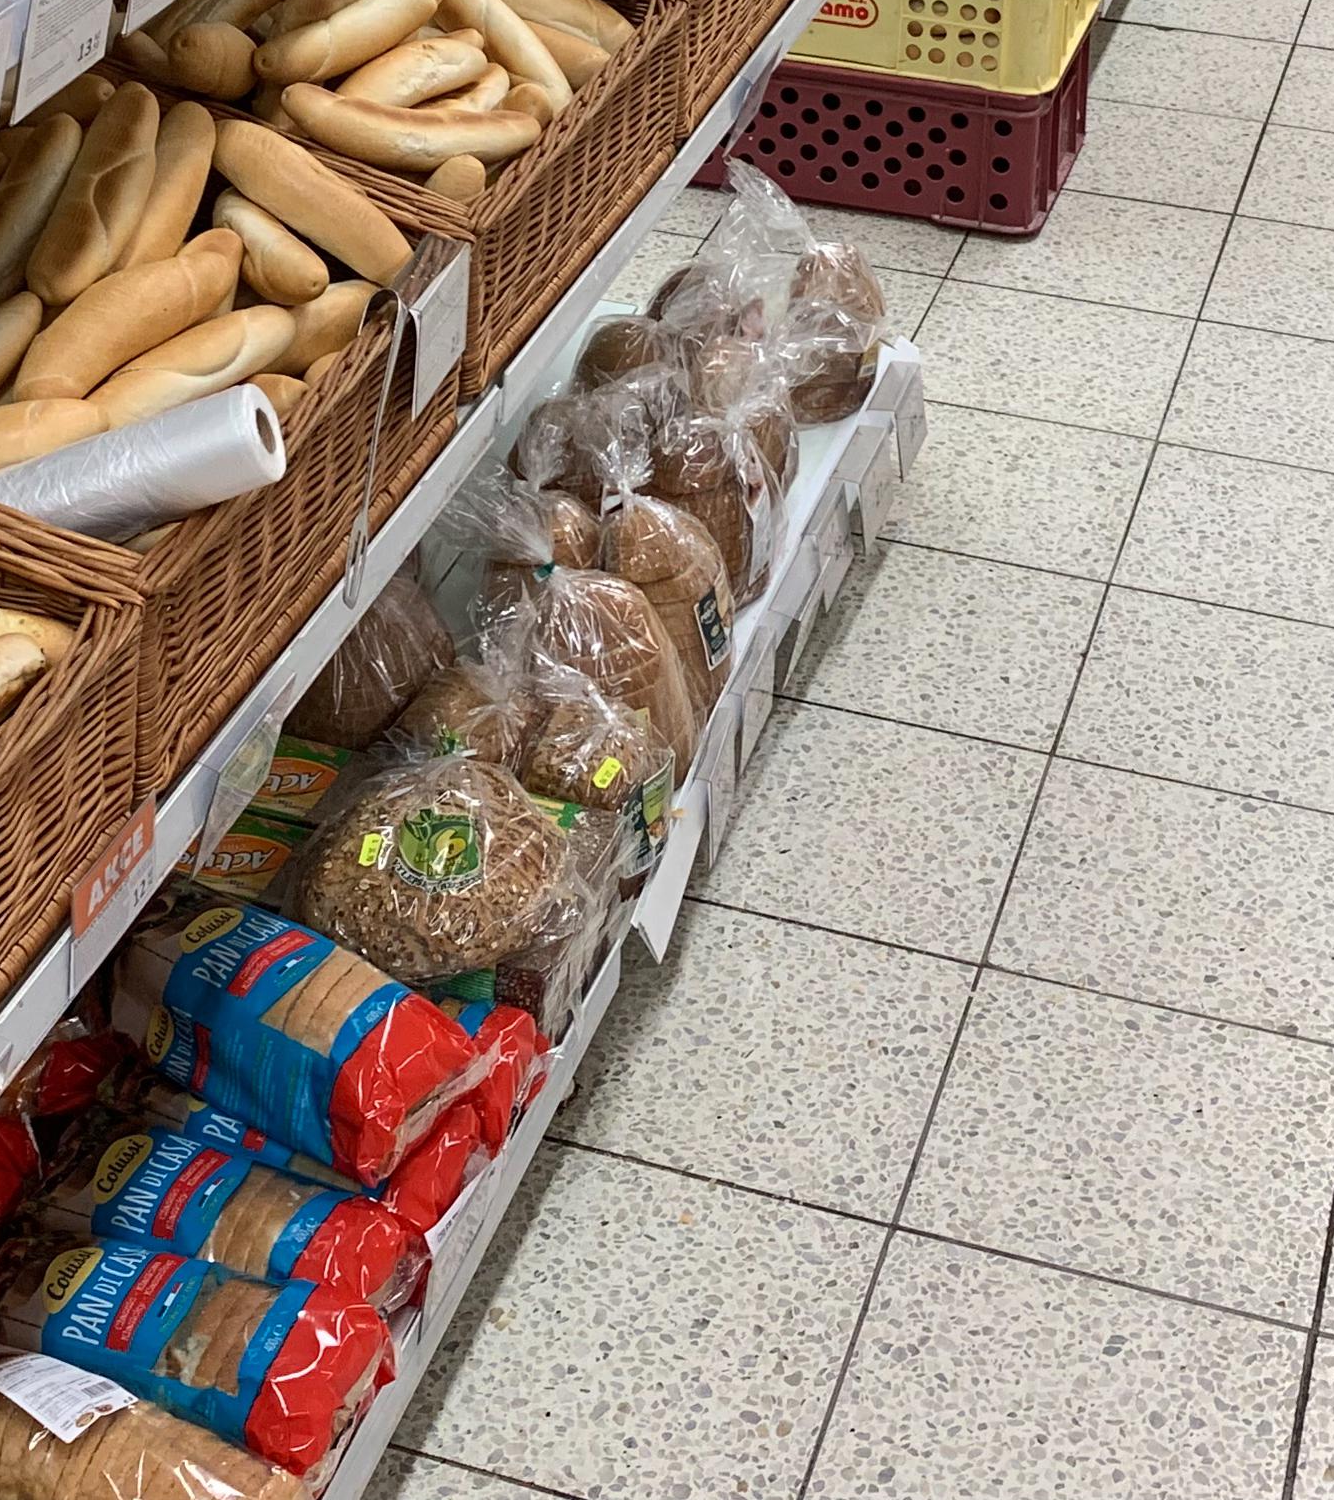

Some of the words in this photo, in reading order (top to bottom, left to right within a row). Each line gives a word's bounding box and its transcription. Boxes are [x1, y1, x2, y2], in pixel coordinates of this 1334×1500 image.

[819, 1, 870, 21] amo
[87, 822, 144, 917] AKCE
[185, 908, 238, 945] Colussi
[192, 941, 243, 989] PAN
[232, 931, 254, 949] DI
[245, 912, 290, 944] CASA
[96, 1139, 145, 1195] Colussi
[139, 1168, 168, 1188] DI
[147, 1133, 203, 1173] CASA
[110, 1186, 160, 1235] PAN
[45, 1249, 95, 1302] Colussi
[61, 1292, 116, 1347] PAN
[92, 1275, 124, 1296] DI
